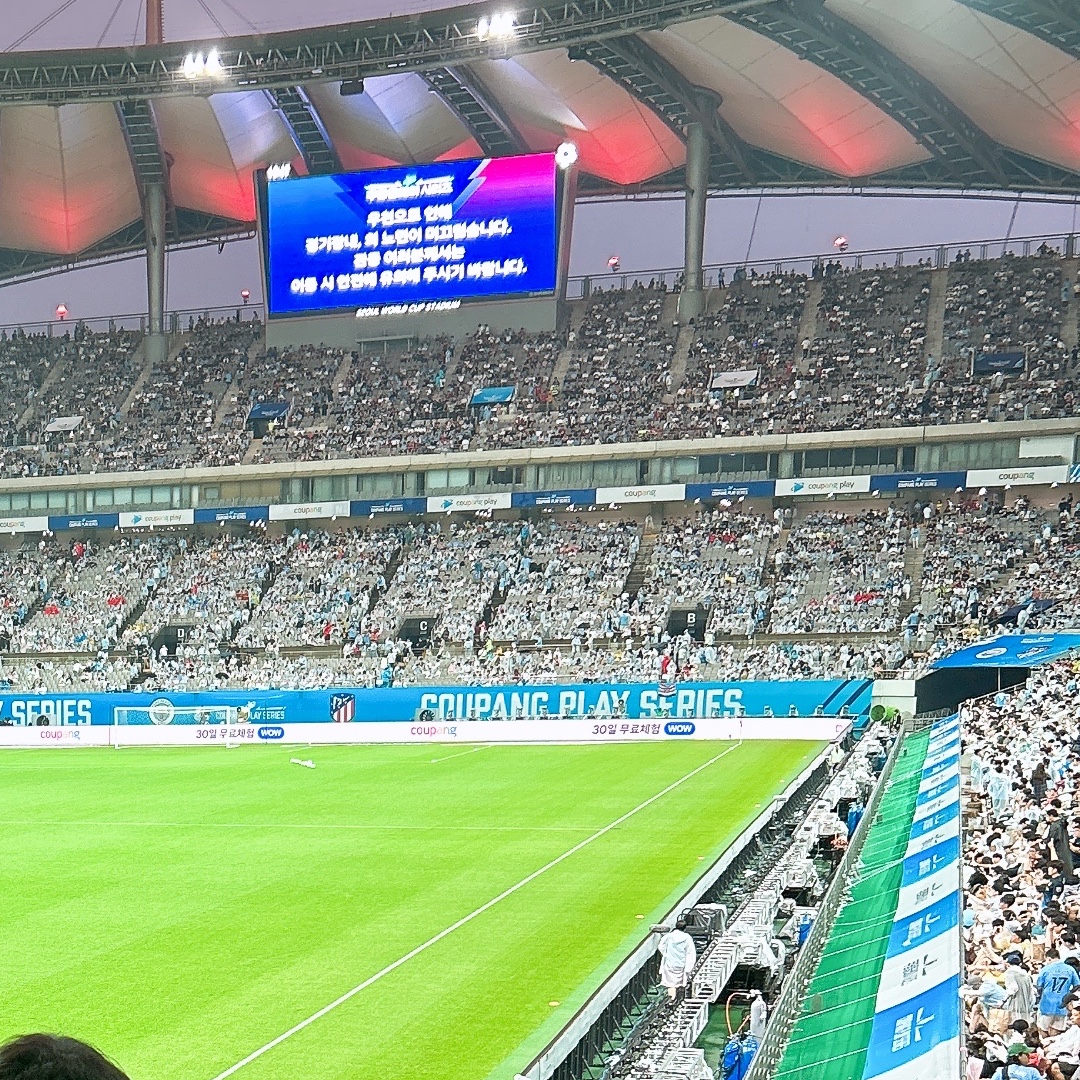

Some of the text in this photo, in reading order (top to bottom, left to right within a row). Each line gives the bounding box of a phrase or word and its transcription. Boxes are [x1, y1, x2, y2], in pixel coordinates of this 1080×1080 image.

[408, 302, 426, 313] CUP
[998, 471, 1035, 481] coupang
[687, 613, 696, 624] B
[559, 690, 631, 719] PLAY
[196, 729, 217, 739] 30일
[260, 728, 282, 737] WOW
[410, 727, 457, 737] coupang
[592, 723, 693, 735] 30일 무료체험 WOW
[40, 731, 81, 740] coupang
[1052, 977, 1068, 993] 17
